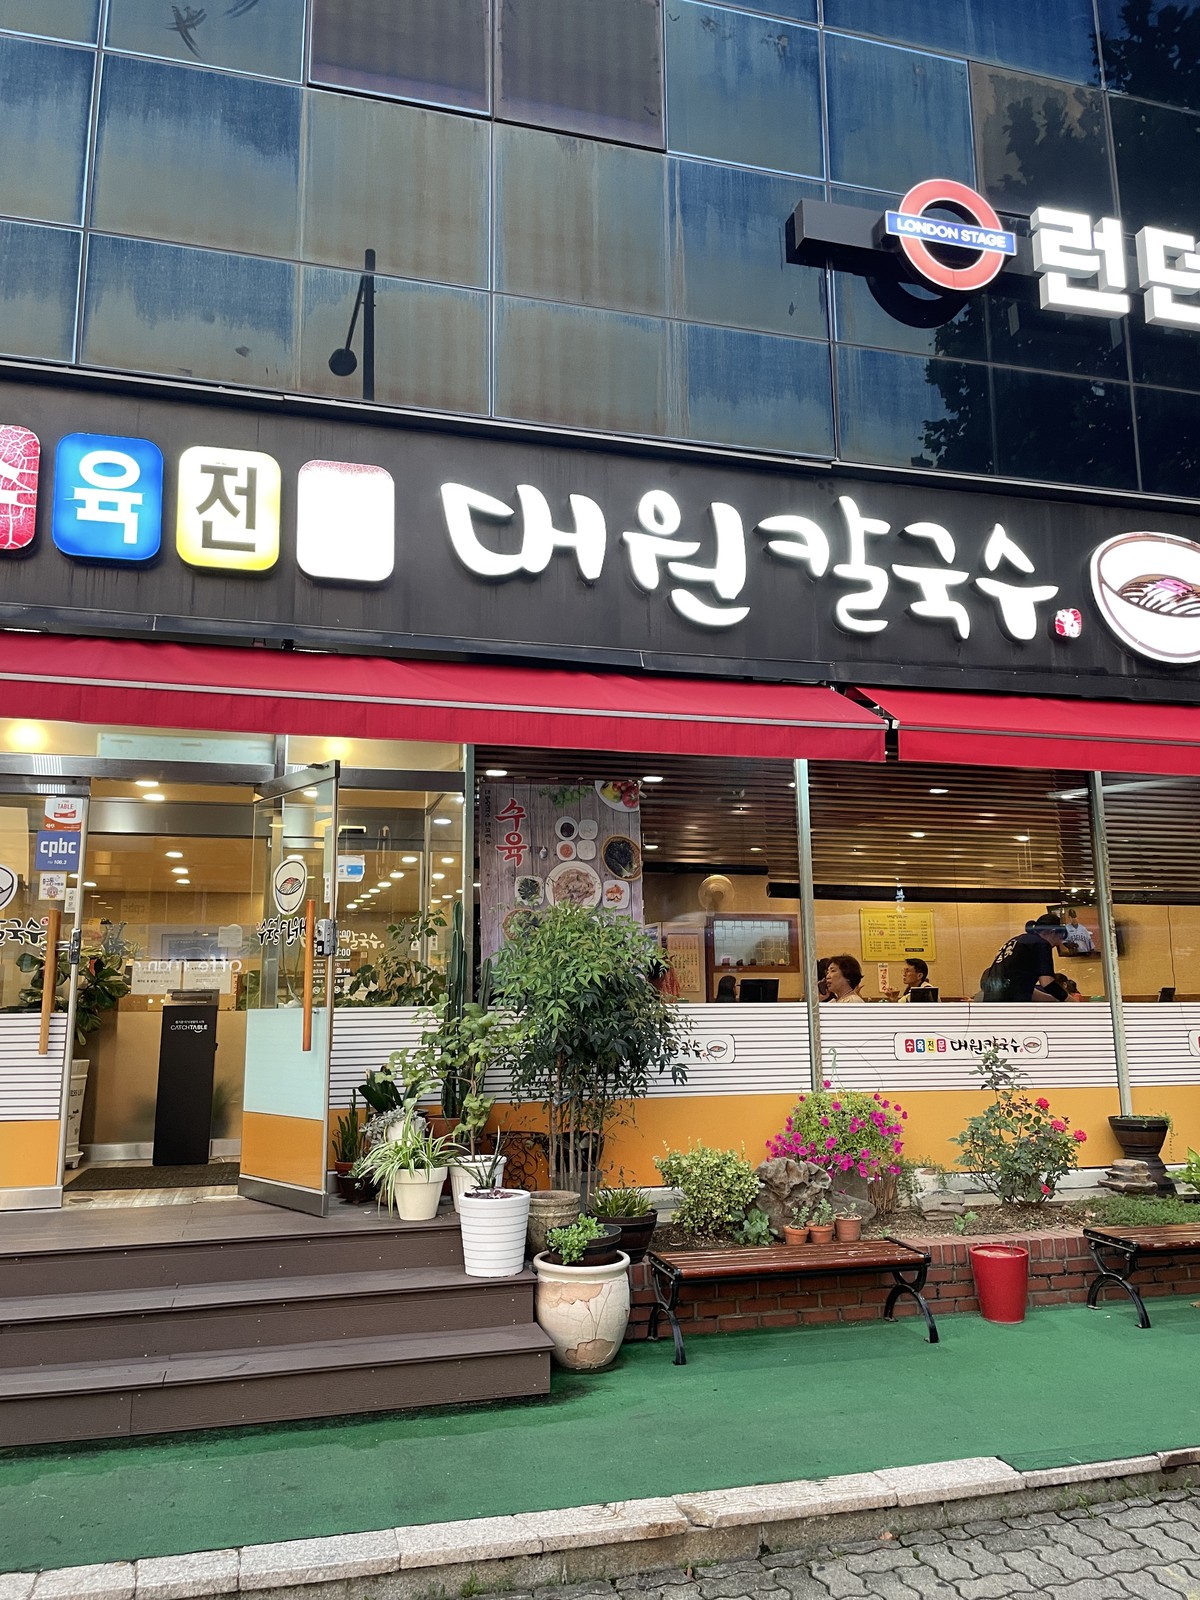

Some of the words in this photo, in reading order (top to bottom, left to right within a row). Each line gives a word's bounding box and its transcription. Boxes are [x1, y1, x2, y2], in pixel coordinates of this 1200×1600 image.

[896, 217, 959, 240] LONDON
[960, 229, 1007, 249] STAGE
[440, 481, 1060, 641] 대원칼국수
[494, 797, 529, 868] 수육
[40, 837, 77, 858] cpbc
[170, 1024, 208, 1033] CATCHTABLE
[905, 1038, 947, 1053] 수육전문
